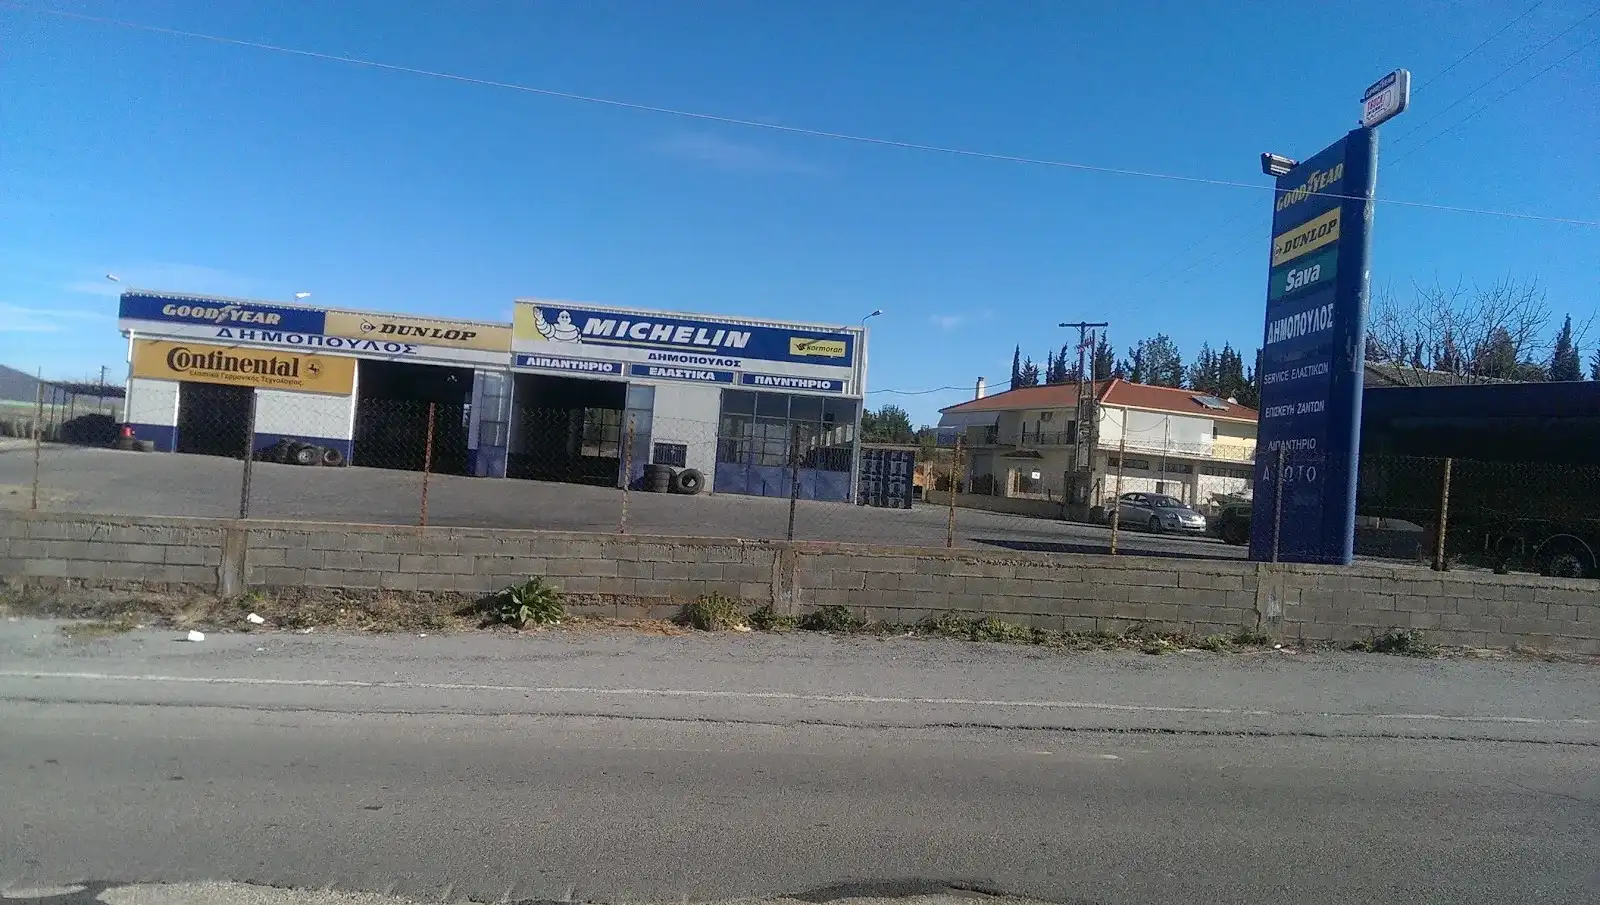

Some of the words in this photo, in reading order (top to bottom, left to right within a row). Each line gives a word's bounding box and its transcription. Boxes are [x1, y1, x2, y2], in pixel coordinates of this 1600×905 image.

[1276, 163, 1344, 212] GOODYEAR
[1283, 218, 1338, 254] DUNLOP
[1285, 263, 1321, 292] Sava
[162, 303, 281, 326] GOODYEAR
[1266, 303, 1334, 345] ΔΗΜΟΠΟΥΛΟΣ
[215, 326, 419, 356] ΔΗΜΟΠΟΥΛΟΣ
[377, 323, 477, 342] DUNLOP
[582, 317, 752, 349] MICHELIN
[807, 344, 843, 354] kormoran
[167, 346, 300, 378] Continental
[526, 356, 614, 373] ΛΙΠΑΝΤΗΡΙΟ
[648, 352, 742, 368] ΔΗΜΟΠΟΥΛΟΣ
[649, 366, 716, 381] ΕΛΑΣΤΙΚΑ
[754, 375, 831, 390] ΠΛΥΝΤΗΡΙΟ
[1263, 370, 1290, 385] SERVICE
[1291, 362, 1329, 380] ΕΛΑΣΤΙΚΩΝ
[1265, 405, 1295, 418] ΕΠΙΣΚΕΥΗ
[1296, 400, 1325, 414] ΖΑΝΤΩΝ
[1267, 438, 1317, 451] ΛΙΠΑΝΤΗΡΙΟ
[1262, 465, 1317, 482] ΑΩΤΟ
